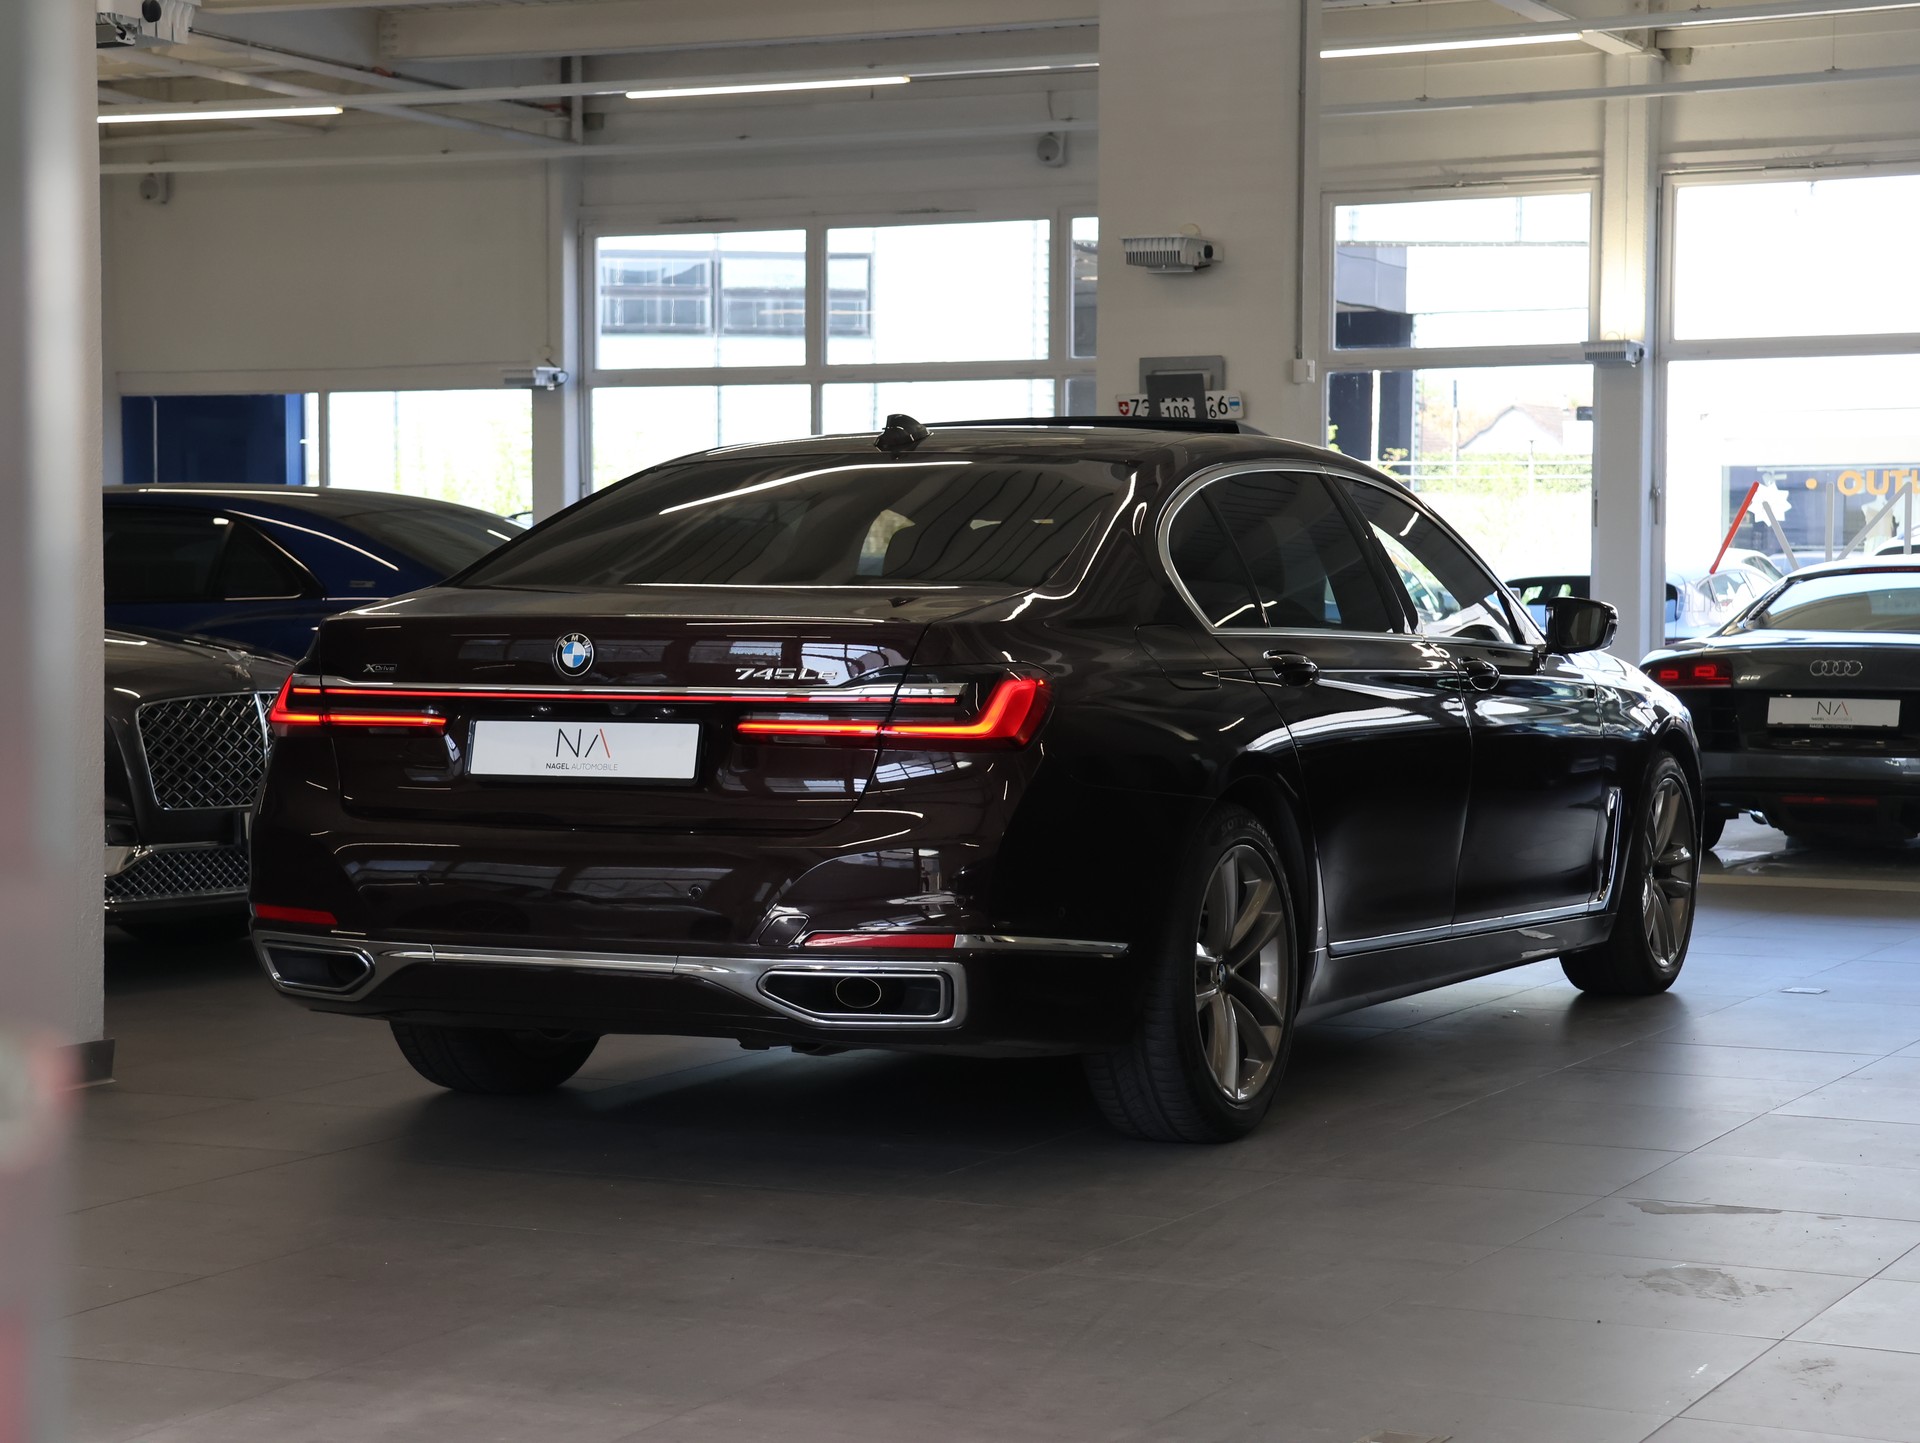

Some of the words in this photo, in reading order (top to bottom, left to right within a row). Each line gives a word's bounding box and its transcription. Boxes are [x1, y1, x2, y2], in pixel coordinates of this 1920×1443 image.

[560, 634, 591, 648] BMW
[735, 667, 838, 681] 745Le
[1817, 701, 1849, 716] NA
[555, 728, 611, 758] NA
[545, 762, 570, 770] NAGEL
[571, 763, 618, 771] AUTOMOBILE
